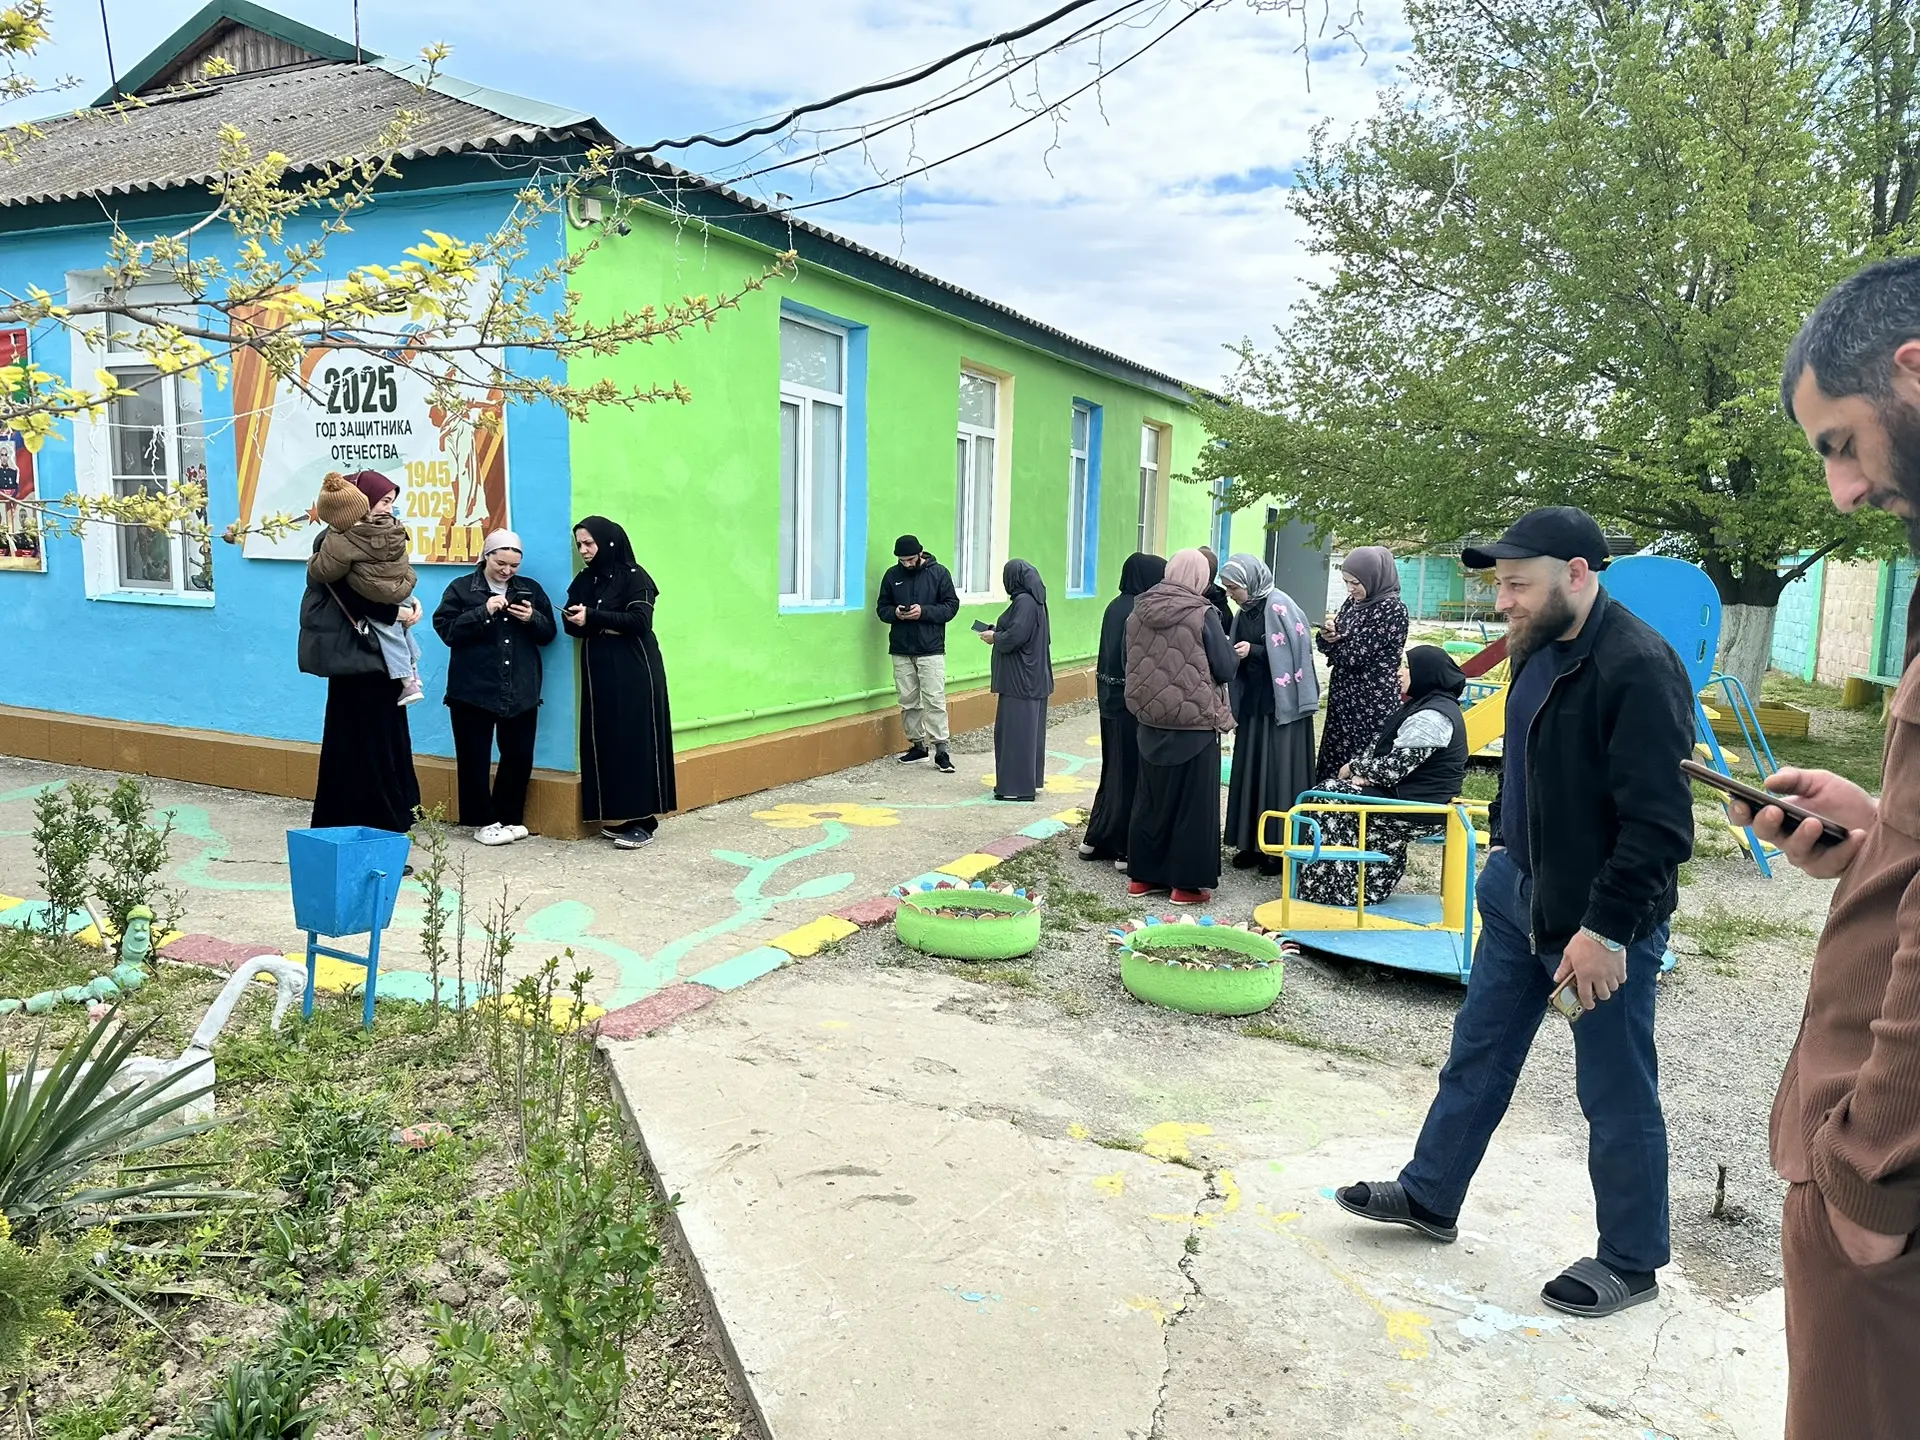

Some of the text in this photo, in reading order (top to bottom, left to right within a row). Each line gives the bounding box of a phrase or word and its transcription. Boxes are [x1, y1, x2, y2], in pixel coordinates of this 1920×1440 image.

[324, 365, 398, 415] 2025
[315, 419, 413, 440] ГОД ЗАЩИТНИКА
[331, 443, 399, 460] ОТЕЧЕСТВА
[404, 460, 452, 489] 1945
[405, 490, 456, 519] 2025
